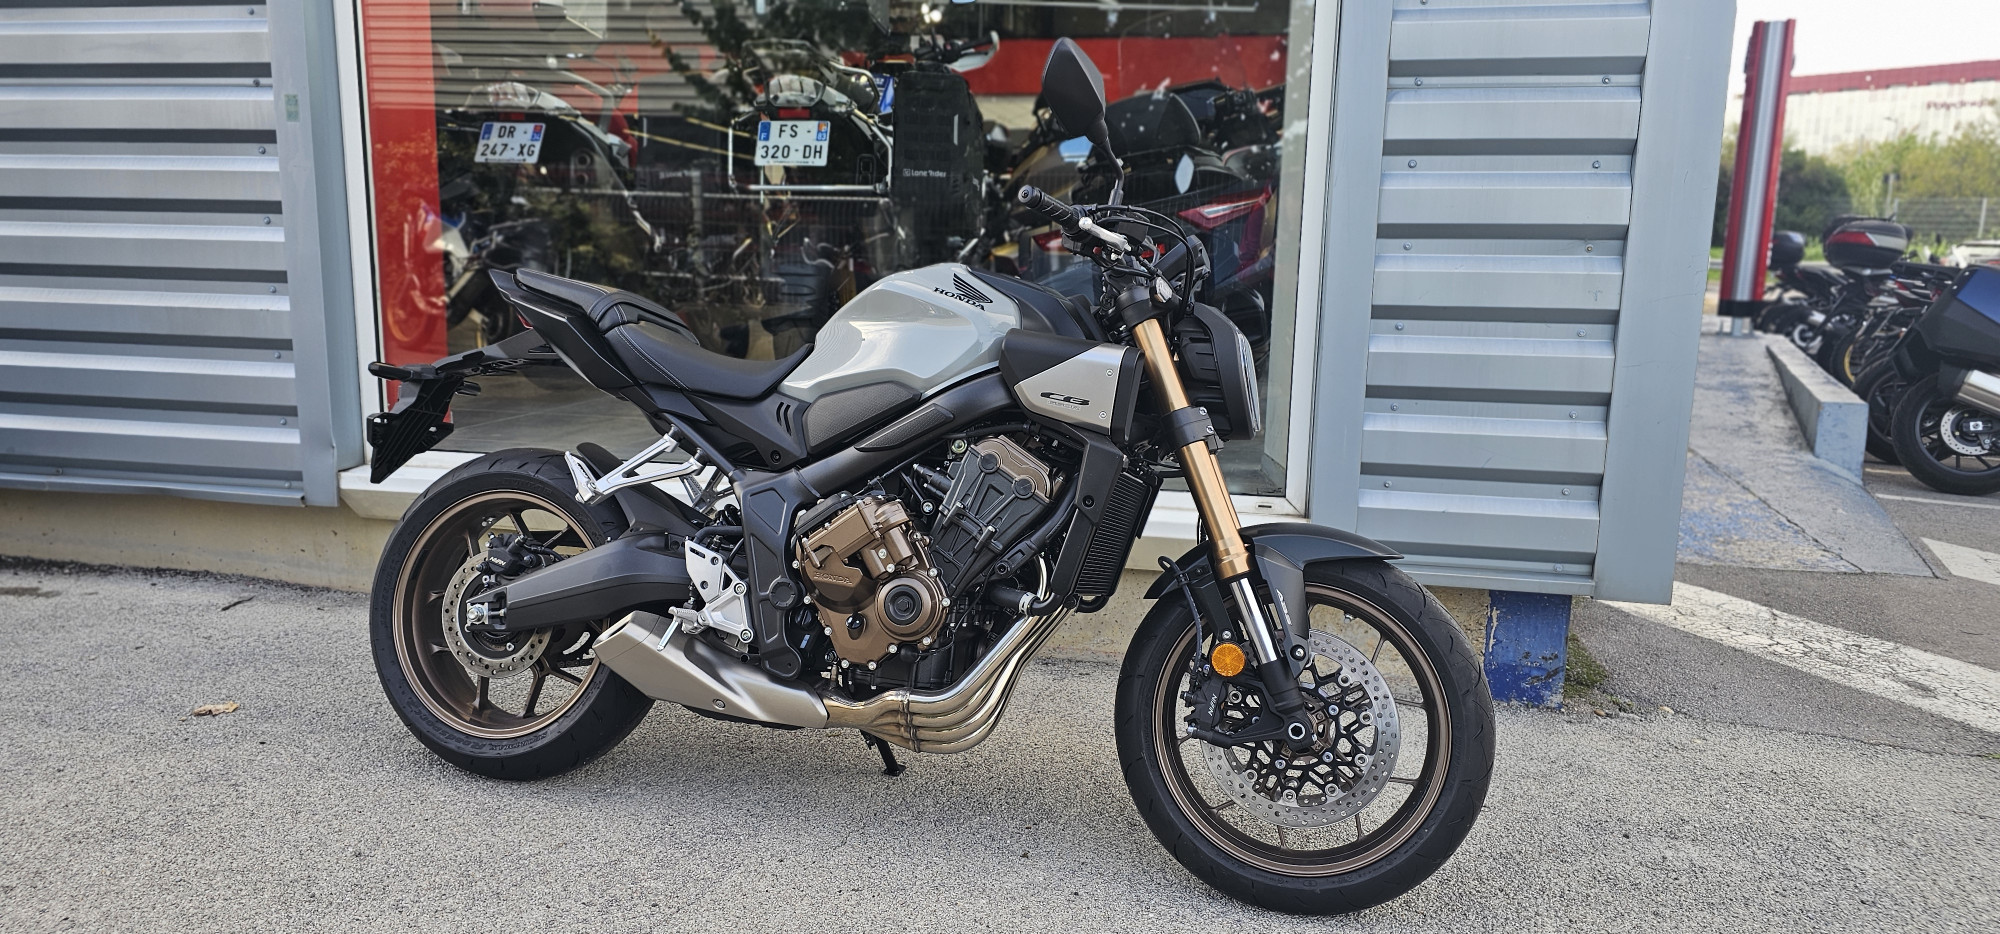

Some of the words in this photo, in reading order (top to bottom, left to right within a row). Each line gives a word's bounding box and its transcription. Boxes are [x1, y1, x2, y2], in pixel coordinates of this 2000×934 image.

[498, 125, 516, 139] DR
[778, 124, 799, 138] FS
[760, 144, 823, 159] 320-DH
[933, 286, 986, 311] HONDA
[1040, 392, 1090, 406] CB
[813, 571, 853, 585] HONDA
